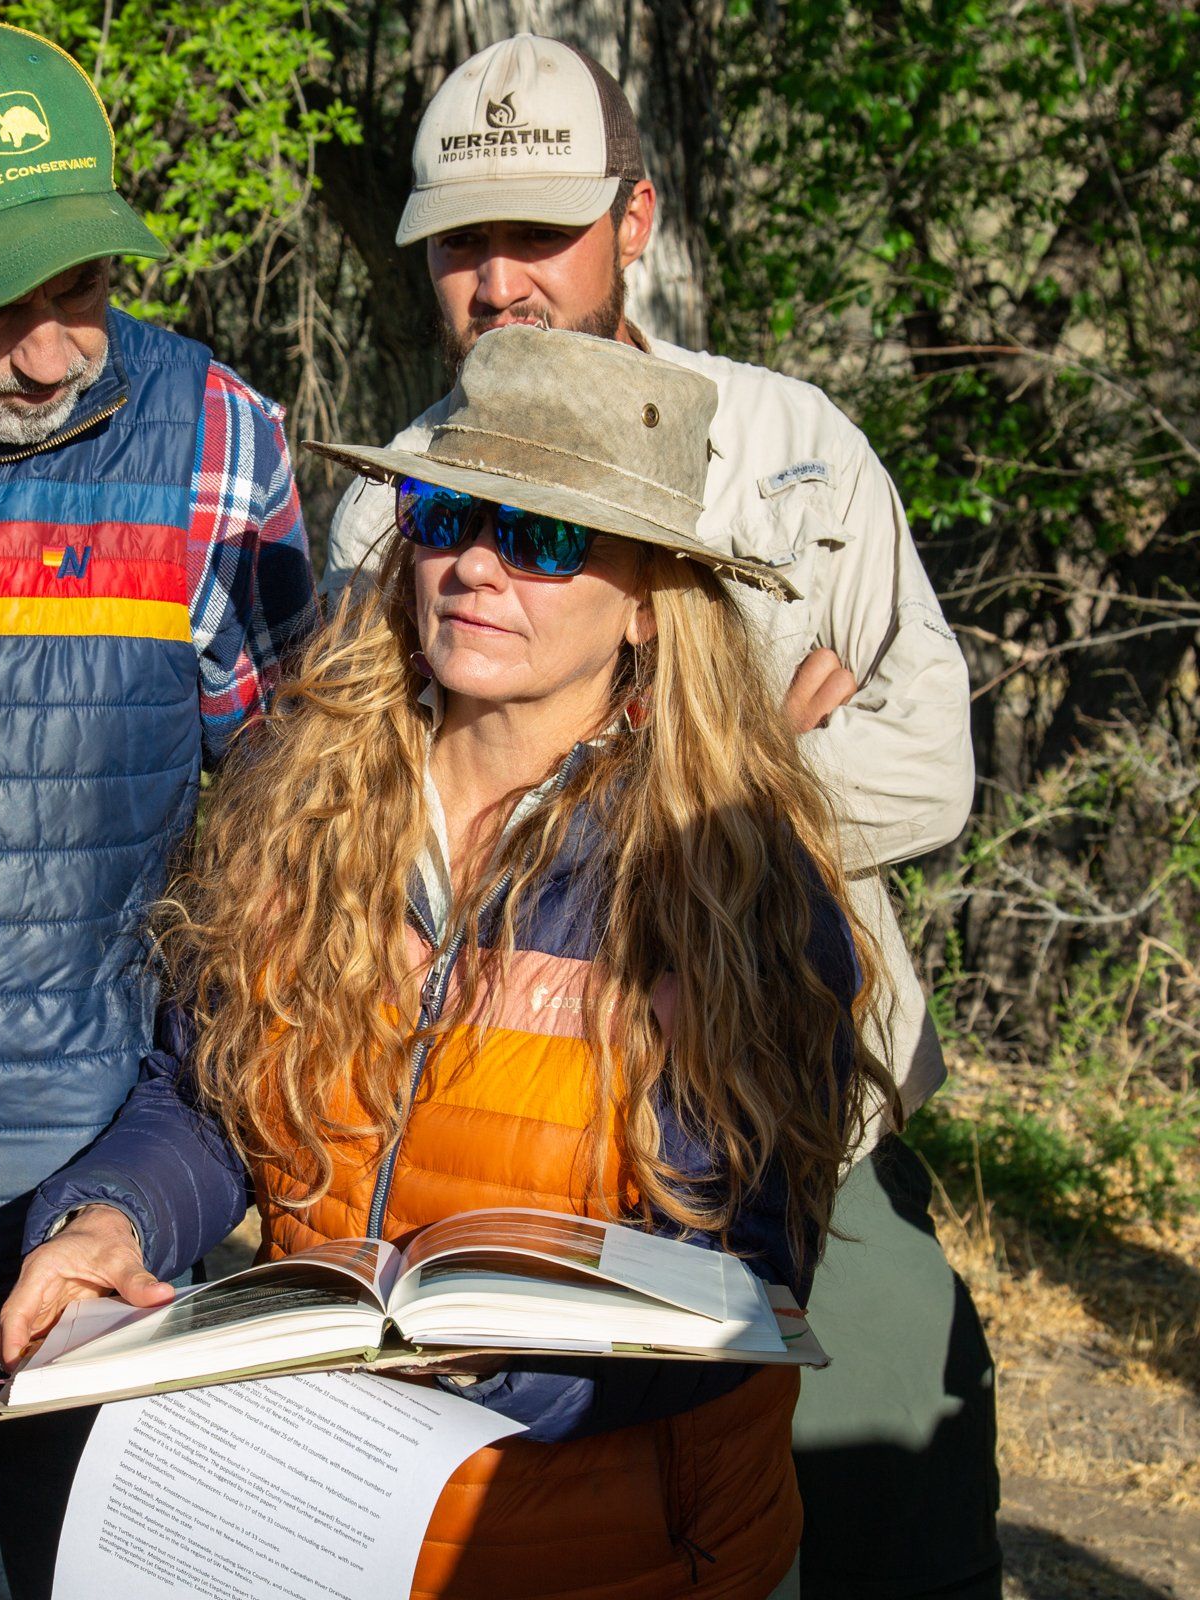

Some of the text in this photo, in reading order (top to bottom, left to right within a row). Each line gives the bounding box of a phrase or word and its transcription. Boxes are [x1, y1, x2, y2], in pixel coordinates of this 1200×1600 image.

[438, 146, 518, 164] INDUSTRIES
[547, 145, 572, 156] LLC
[440, 128, 571, 152] VERSATILE
[784, 463, 826, 476] Columbia
[148, 1395, 163, 1408] native
[162, 1403, 186, 1421] Red-eared
[184, 1417, 200, 1430] sliders
[199, 1426, 211, 1435] now
[205, 1390, 229, 1406] Terrapene
[243, 1411, 260, 1424] Found
[269, 1425, 281, 1436] least
[292, 1439, 302, 1448] the
[329, 1460, 341, 1469] with
[340, 1466, 364, 1483] extensive
[363, 1479, 385, 1495] numbers
[123, 1448, 146, 1463] potential
[132, 1426, 157, 1443] determine
[172, 1447, 182, 1457] full
[212, 1472, 238, 1489] suggested
[243, 1489, 260, 1501] recent
[140, 1420, 154, 1430] other
[173, 1438, 195, 1455] including
[210, 1458, 220, 1468] The
[218, 1464, 247, 1484] populations
[252, 1482, 265, 1494] Eddy
[264, 1489, 283, 1504] County
[282, 1500, 296, 1510] need
[295, 1505, 314, 1520] further
[313, 1517, 333, 1531] genetic
[332, 1527, 362, 1546] refinement
[141, 1408, 155, 1420] Pond
[167, 1423, 192, 1442] Trachemys
[208, 1447, 227, 1461] Natives
[225, 1456, 241, 1469] found
[249, 1471, 270, 1486] counties
[269, 1482, 281, 1491] and
[279, 1488, 307, 1506] non-native
[305, 1501, 335, 1522] (red-eared)
[334, 1516, 351, 1530] found
[362, 1532, 375, 1543] least
[187, 1407, 211, 1425] Trachemys
[229, 1431, 246, 1444] Found
[286, 1463, 309, 1481] including
[324, 1485, 358, 1507] Hybridization
[357, 1503, 369, 1513] with
[112, 1482, 128, 1496] Poorly
[127, 1492, 155, 1510] understood
[154, 1506, 171, 1518] within
[170, 1514, 180, 1523] the
[119, 1460, 136, 1474] Sonora
[135, 1469, 148, 1481] Mud
[162, 1485, 191, 1505] Kinosternon
[218, 1515, 235, 1528] Found
[128, 1439, 143, 1451] Yellow
[142, 1447, 155, 1458] Mud
[168, 1463, 197, 1482] Kinosternon
[222, 1492, 239, 1505] Found
[257, 1511, 266, 1521] the
[296, 1532, 320, 1550] including
[337, 1554, 350, 1564] with
[349, 1561, 364, 1571] some
